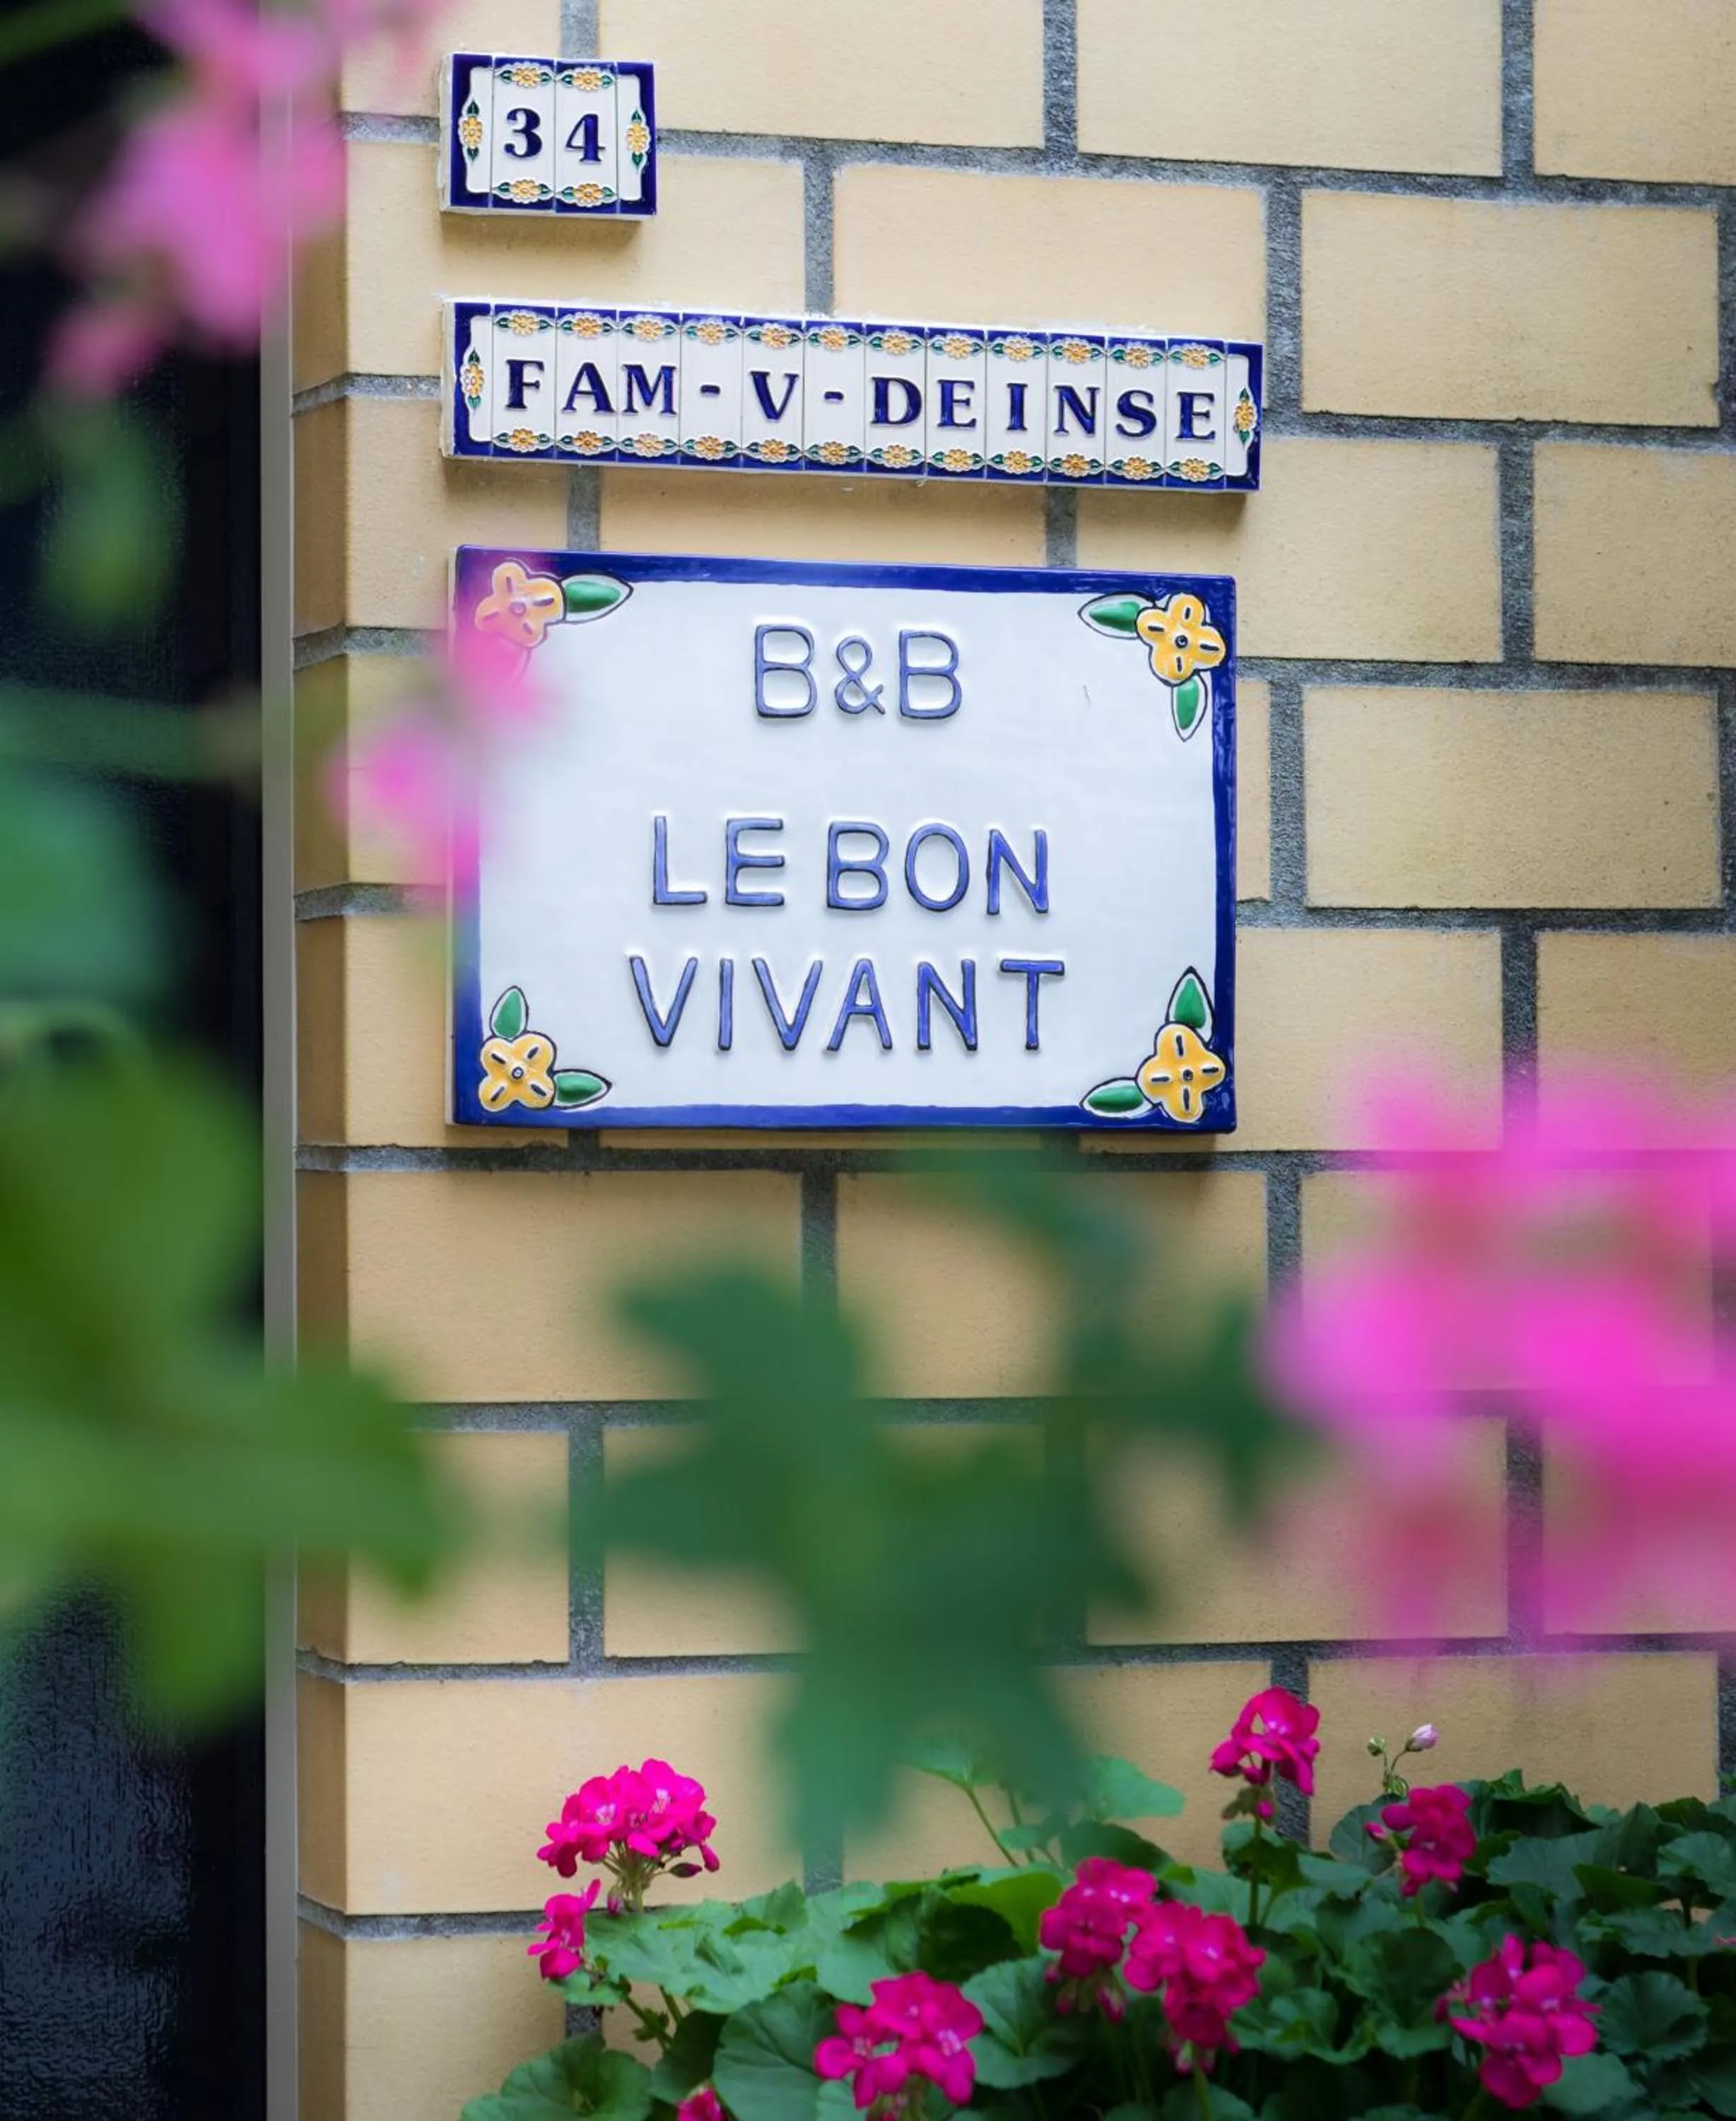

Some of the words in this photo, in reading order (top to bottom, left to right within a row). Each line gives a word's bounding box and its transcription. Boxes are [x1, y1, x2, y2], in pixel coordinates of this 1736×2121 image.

[503, 107, 606, 164] 34
[753, 624, 963, 720] B&B
[652, 815, 786, 907] LE
[826, 820, 1050, 915] BON
[628, 954, 1066, 1051] VIVANT
